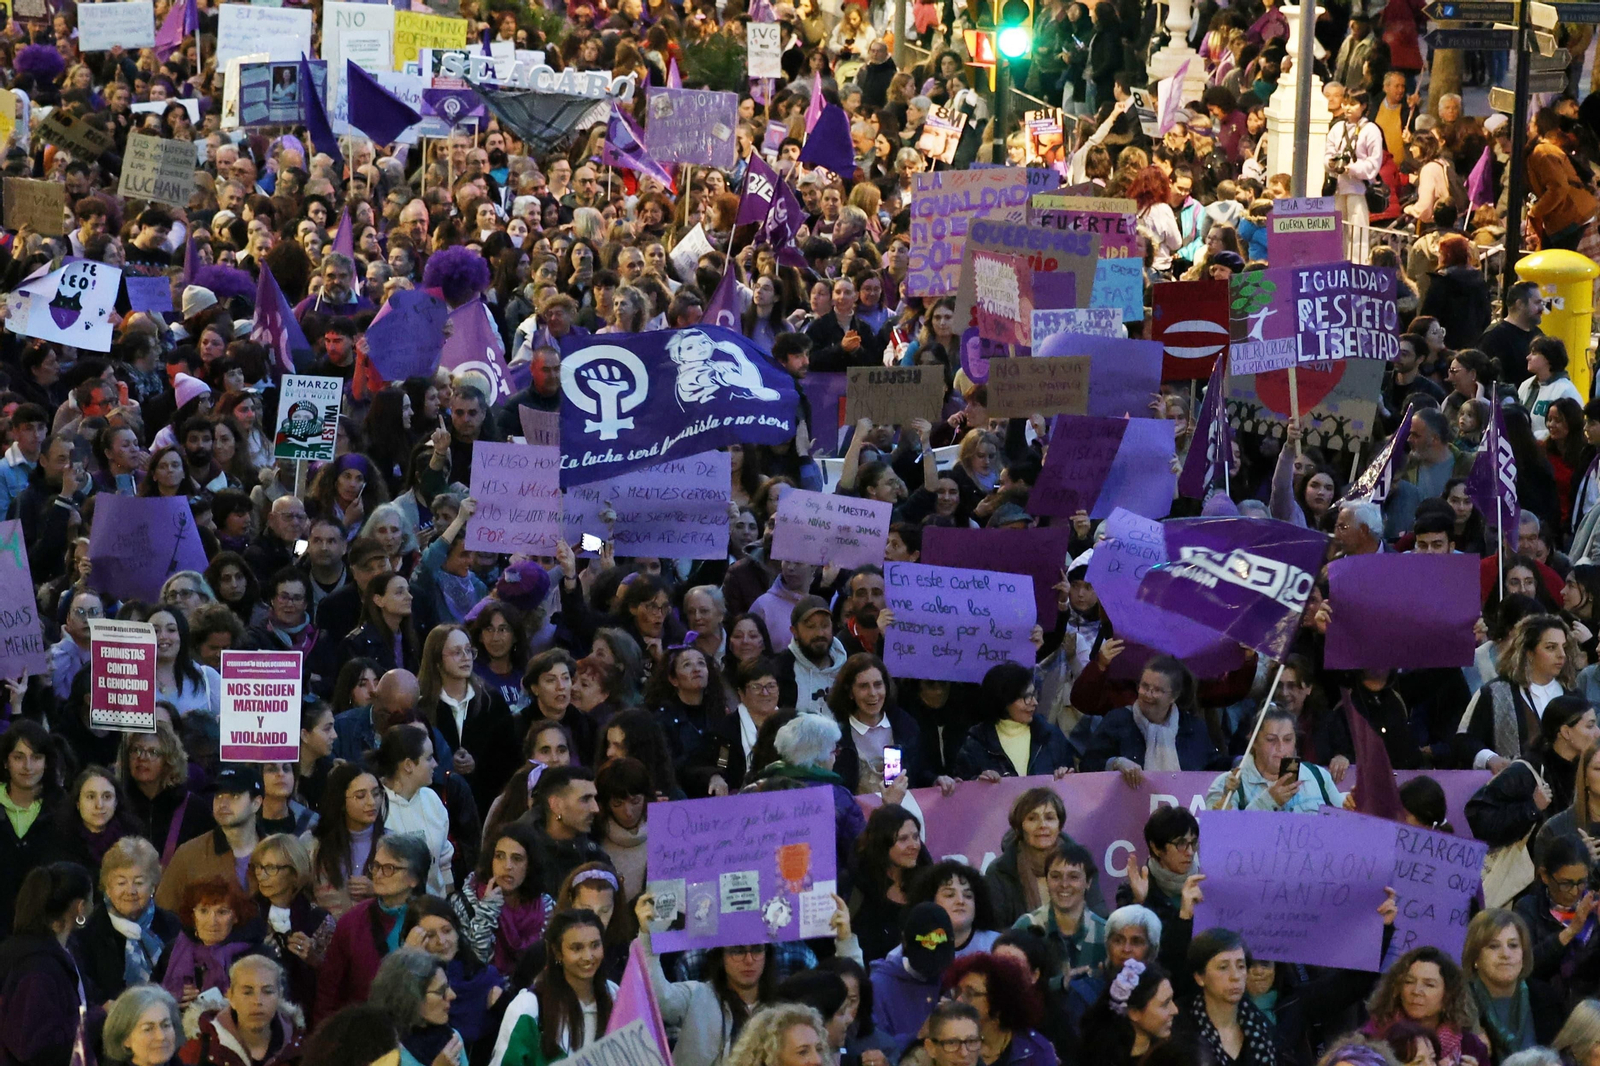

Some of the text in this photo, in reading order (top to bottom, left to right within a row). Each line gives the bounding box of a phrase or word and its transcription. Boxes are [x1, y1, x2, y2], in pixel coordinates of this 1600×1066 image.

[336, 10, 365, 27] NO
[752, 27, 778, 41] IVG
[917, 172, 942, 191] LA
[1041, 214, 1128, 234] FUERTE
[1299, 268, 1389, 293] IGUALDAD
[1298, 294, 1397, 332] RESPETO
[1297, 326, 1400, 362] LIBERTAD
[286, 379, 338, 390] 8 MARZO
[319, 404, 339, 460] PALESTINA
[582, 449, 623, 467] lucha
[627, 444, 659, 461] será
[723, 415, 735, 427] o
[735, 415, 757, 426] no
[758, 413, 791, 431] será
[294, 450, 321, 459] FREE
[481, 452, 558, 471] VENGO HOY
[693, 460, 717, 478] DE
[480, 478, 510, 496] MIS
[628, 485, 679, 501] MENTES
[480, 503, 502, 522] NO
[509, 508, 546, 523] VENIR
[838, 504, 876, 519] MAESTRA
[477, 525, 558, 549] POR ELLAS
[657, 529, 717, 546] ABIERTA
[889, 565, 910, 587] En
[916, 570, 945, 589] este
[998, 583, 1016, 593] no
[891, 595, 991, 617] me caben las
[889, 617, 1013, 641] razones por las
[100, 646, 146, 660] FEMINISTAS
[892, 641, 917, 660] que
[932, 641, 963, 666] estoy
[107, 662, 138, 675] CONTRA
[98, 676, 149, 691] EL GENOCIDIO
[227, 683, 295, 697] NOS SIGUEN
[108, 692, 138, 706] EN GAZA
[233, 699, 289, 713] MATANDO
[257, 715, 264, 728] Y
[230, 731, 288, 745] VIOLANDO
[1276, 825, 1324, 849] NOS
[1396, 828, 1484, 869] RIARCADO
[1225, 850, 1377, 880] QUITARON
[1257, 879, 1351, 906] TANTO
